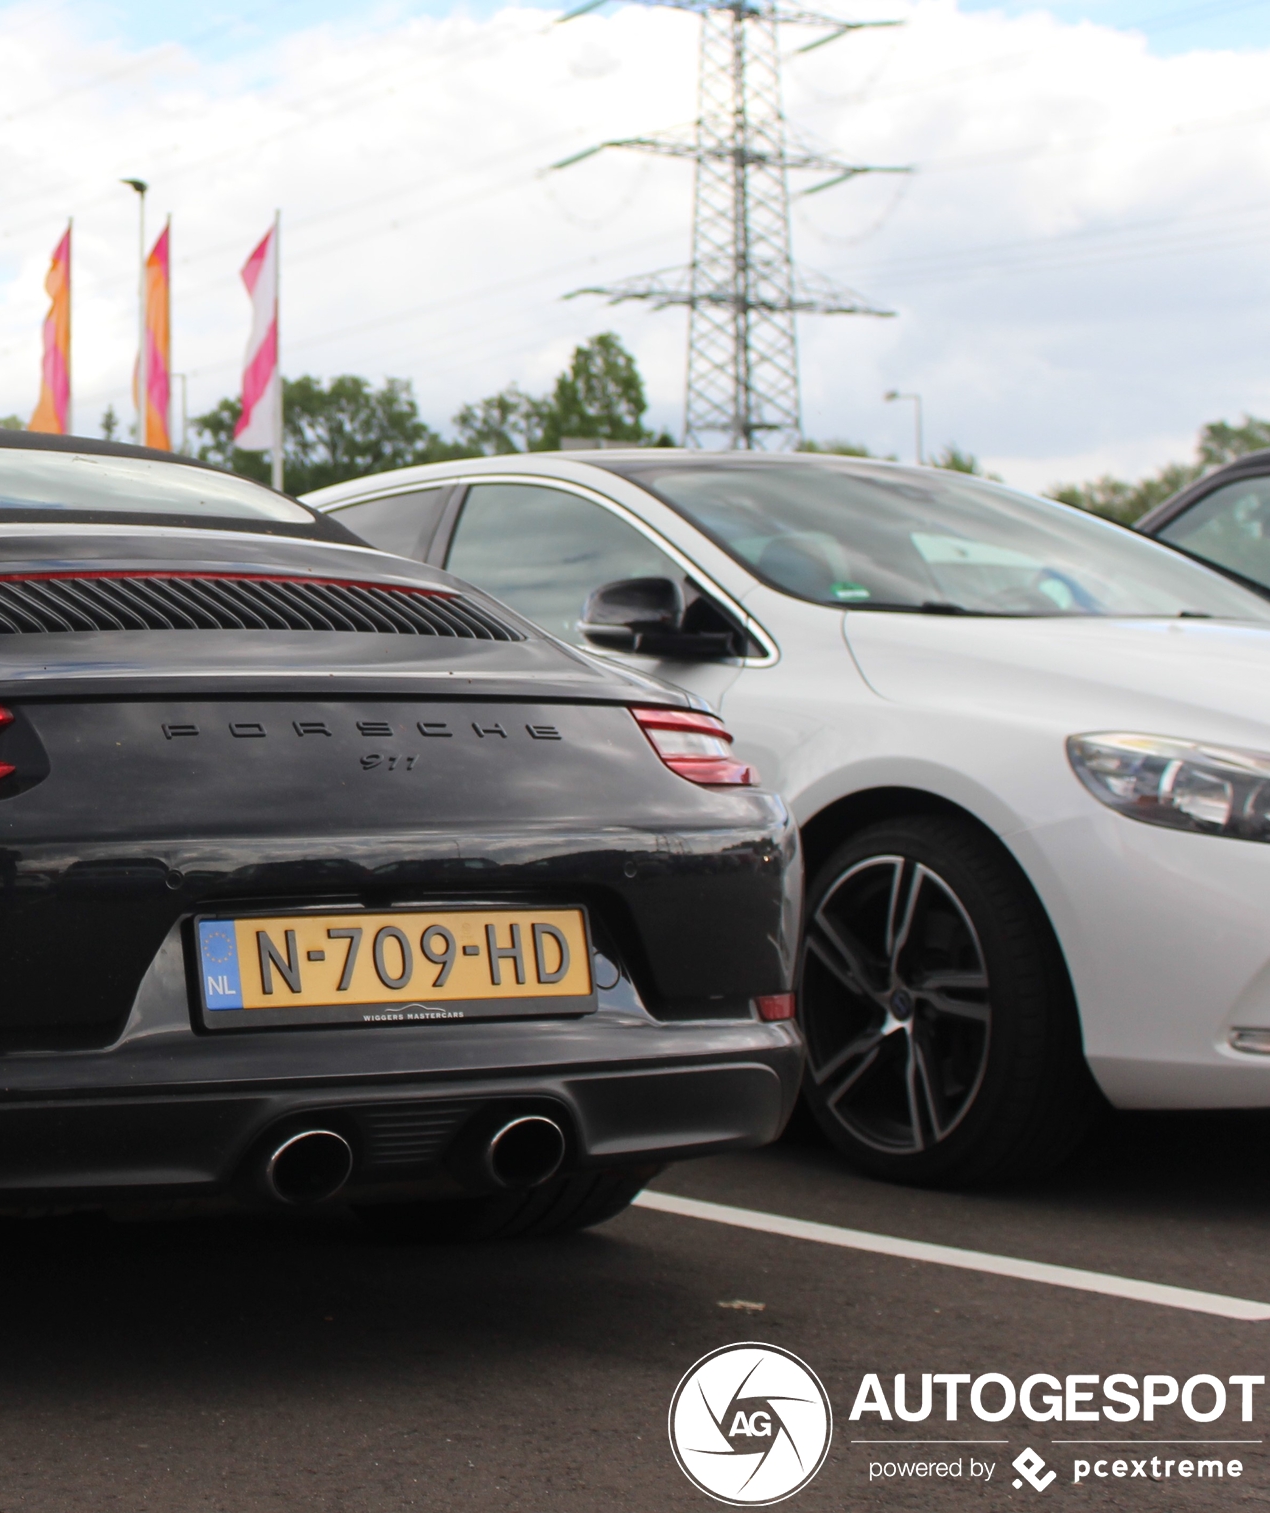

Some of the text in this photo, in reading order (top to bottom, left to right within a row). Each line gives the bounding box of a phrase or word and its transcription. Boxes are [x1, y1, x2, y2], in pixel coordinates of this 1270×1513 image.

[161, 721, 562, 740] PORSCHE
[359, 753, 420, 771] 911
[207, 922, 571, 996] NL N-709-HD
[363, 1011, 464, 1022] WIGGERS MASTERCARS
